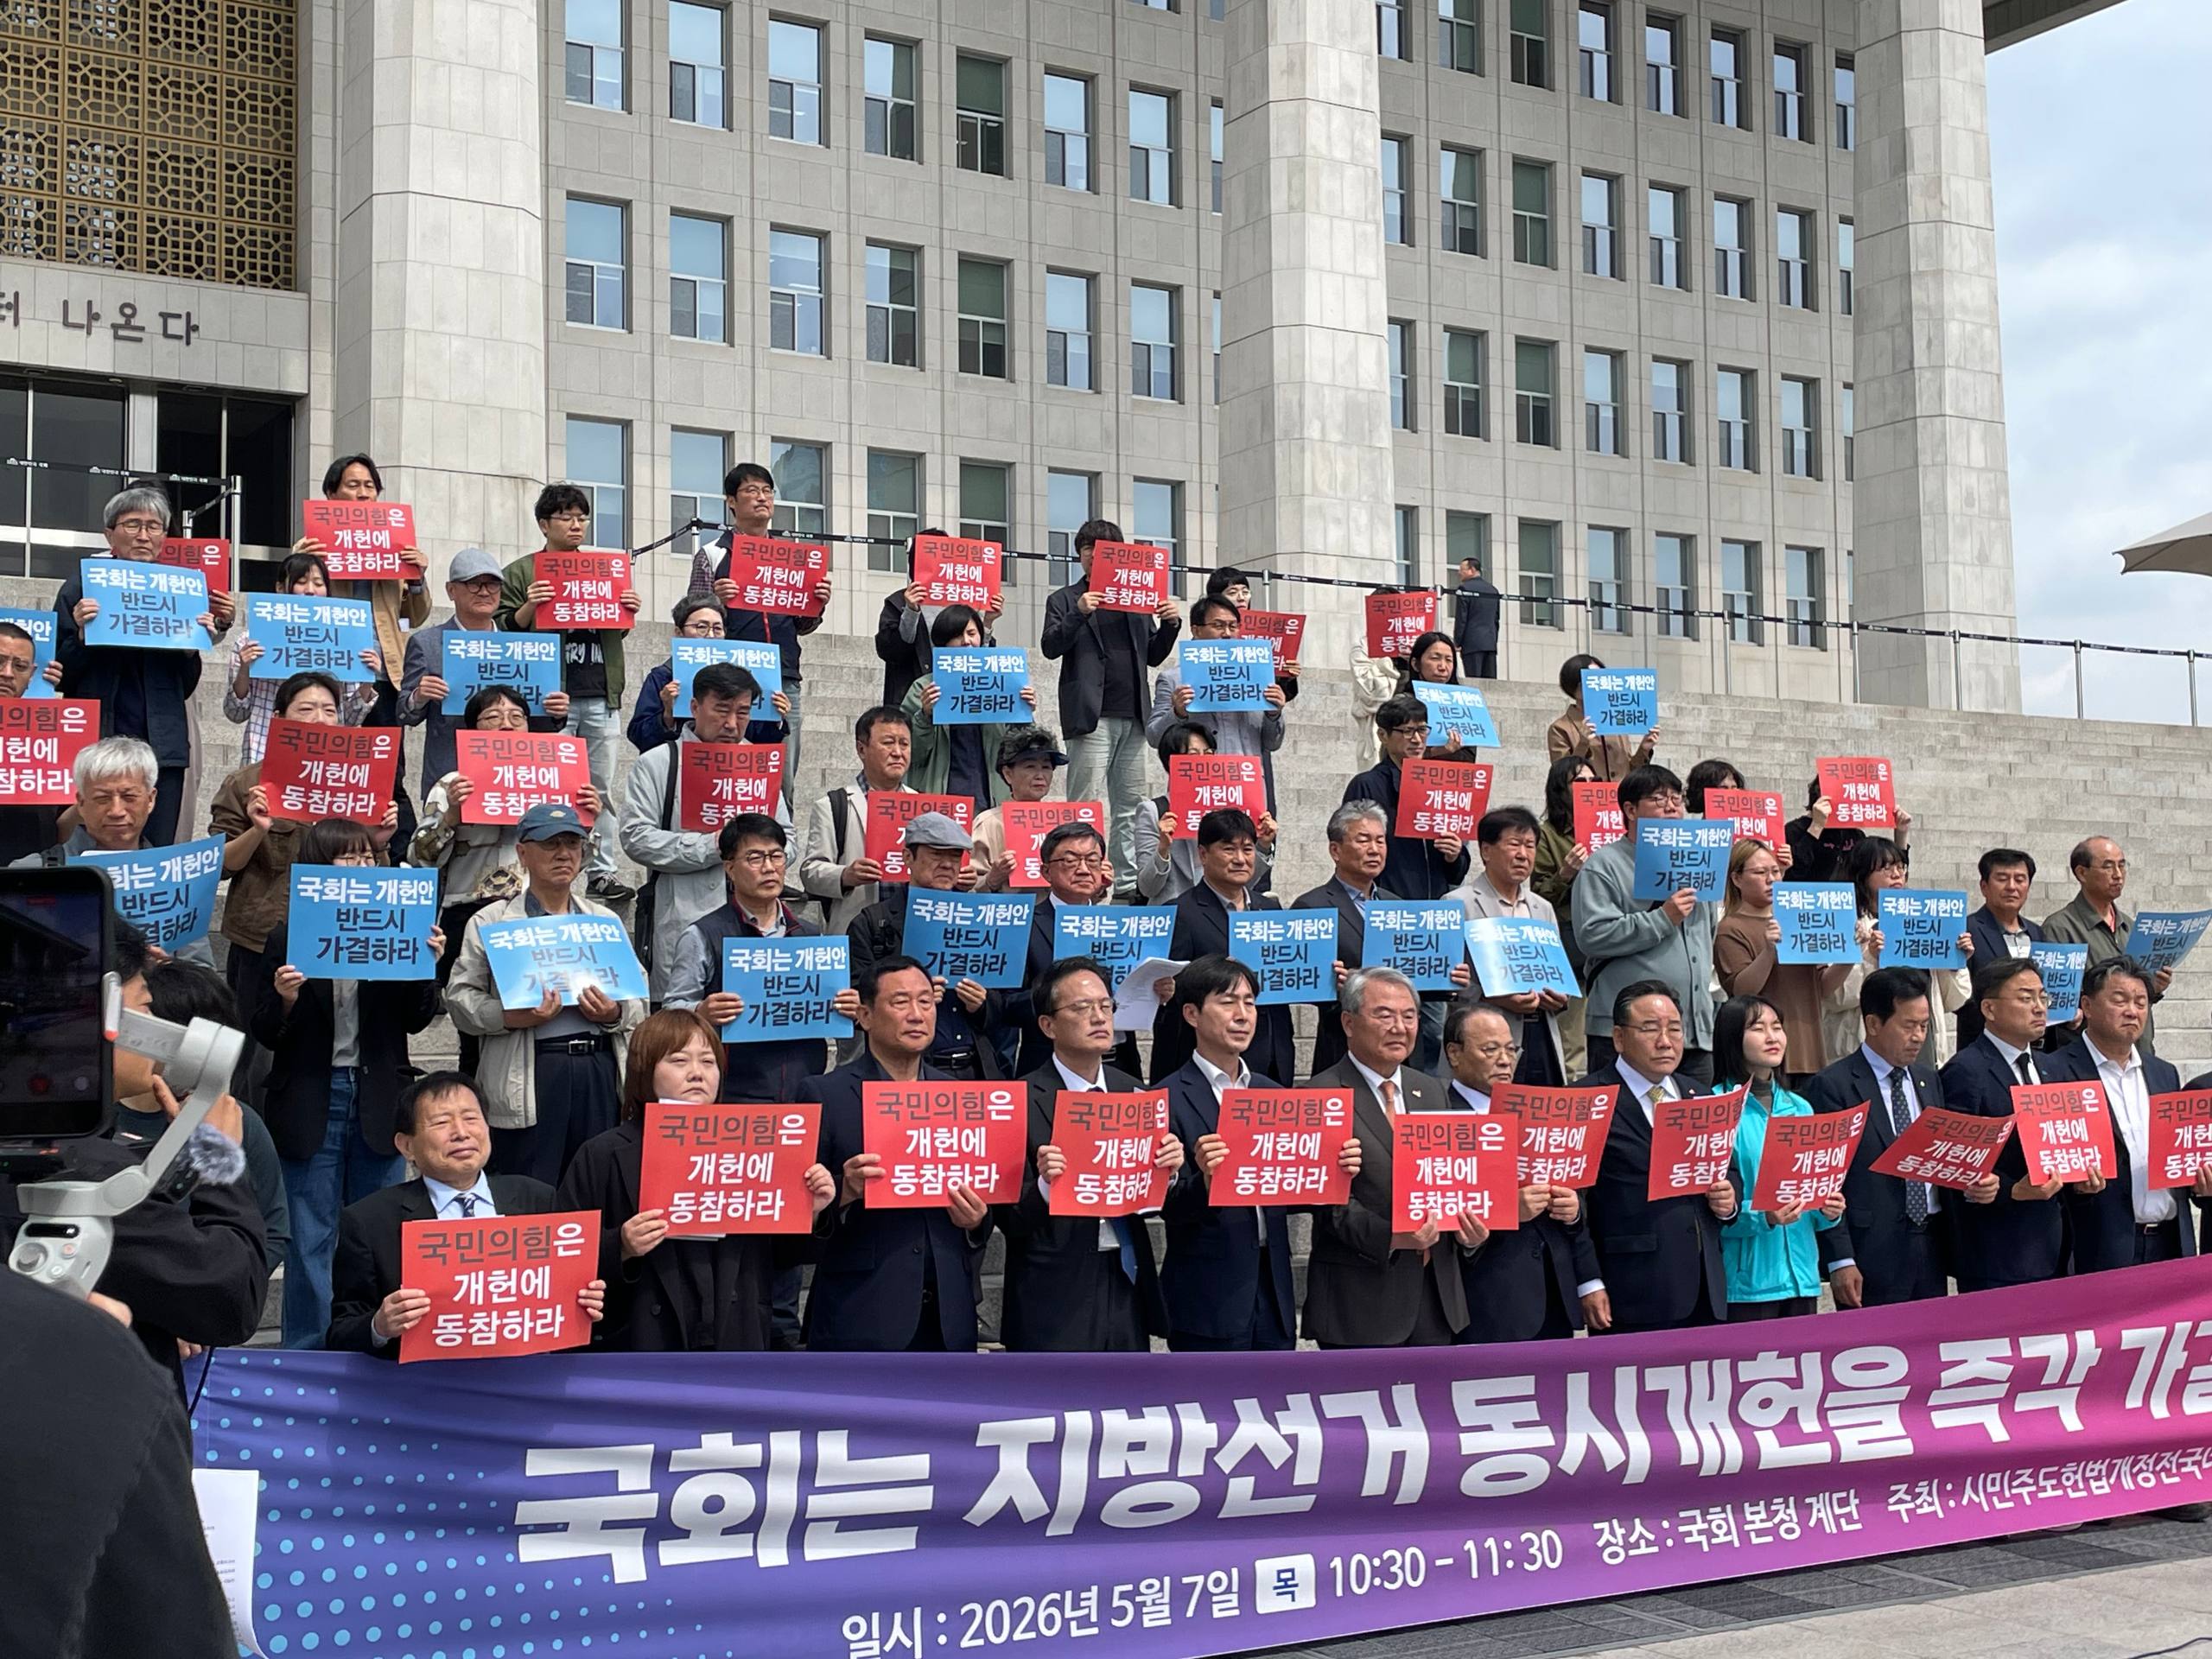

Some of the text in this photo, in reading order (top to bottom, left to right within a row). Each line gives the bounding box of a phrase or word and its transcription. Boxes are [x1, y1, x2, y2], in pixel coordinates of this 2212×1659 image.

[62, 299, 200, 346] 나온다
[313, 505, 406, 529] 국민의힘은
[334, 530, 391, 550] 개헌에
[325, 552, 401, 574] 동참하라
[739, 541, 823, 569] 국민의힘은
[922, 541, 996, 565] 국민의힘은
[1100, 546, 1165, 570] 국민의힘은
[543, 557, 626, 578] 국민의힘은
[754, 565, 805, 589] 개헌에
[938, 563, 982, 584] 개헌에
[1113, 568, 1154, 588] 개헌에
[87, 567, 204, 597] 국회는 개헌안
[562, 581, 613, 600] 개헌에
[929, 582, 989, 605] 동참하라
[121, 592, 177, 614] 반드시
[743, 588, 809, 610] 동참하라
[1103, 586, 1160, 608] 동참하라
[253, 601, 367, 626] 국회는 개헌안
[552, 601, 620, 622] 동참하라
[109, 613, 194, 638] 가결하라
[284, 626, 340, 646] 반드시
[272, 646, 354, 671] 가결하라
[448, 639, 556, 662] 국회는 개헌안
[730, 648, 776, 670] 개헌안
[1183, 645, 1229, 664] 국회는
[1230, 646, 1270, 664] 개헌안
[478, 662, 529, 682] 반드시
[937, 655, 1025, 673] 국회는 개헌안
[1208, 665, 1250, 682] 반드시
[961, 674, 1005, 693] 반드시
[1198, 683, 1262, 702] 가결하라
[1586, 674, 1655, 692] 국회는 개헌안
[950, 693, 1015, 715] 가결하라
[1607, 692, 1641, 709] 반드시
[1438, 706, 1473, 721] 반드시
[1599, 709, 1648, 727] 가결하라
[278, 727, 391, 760] 국민의힘은
[467, 737, 578, 765] 국민의힘은
[692, 748, 780, 774] 국민의힘은
[1178, 761, 1256, 783] 국민의힘은
[298, 760, 370, 789] 개헌에
[493, 766, 560, 790] 개헌에
[1409, 765, 1487, 790] 국민의힘은
[281, 785, 377, 817] 동참하라
[712, 779, 767, 801] 개헌에
[1194, 785, 1243, 806] 개헌에
[1424, 790, 1472, 812] 개헌에
[1843, 783, 1880, 802] 개헌에
[1413, 811, 1474, 836] 동참하라
[1836, 803, 1887, 823] 동참하라
[1642, 827, 1692, 848] 국회는
[1694, 828, 1730, 848] 개헌안
[160, 849, 220, 881] 개헌안
[1669, 849, 1711, 868] 반드시
[296, 876, 435, 906] 국회는 개헌안
[1654, 871, 1717, 892] 가결하라
[122, 885, 190, 918] 반드시
[912, 899, 1030, 926] 국회는 개헌안
[1776, 891, 1853, 911] 국회는 개헌안
[1883, 897, 1964, 918] 국회는 개헌안
[336, 907, 406, 933] 반드시
[1060, 916, 1171, 938] 국회는 개헌안
[1234, 918, 1334, 943] 국회는 개헌안
[1370, 909, 1461, 931] 국회는 개헌안
[1798, 912, 1835, 931] 반드시
[1904, 918, 1942, 937] 반드시
[2137, 918, 2176, 936] 국회는
[489, 923, 622, 950] 국회는 개헌안
[943, 928, 999, 950] 반드시
[1394, 933, 1440, 953] 반드시
[1791, 932, 1847, 953] 가결하라
[1894, 938, 1950, 958] 가결하라
[2153, 936, 2187, 950] 반드시
[316, 937, 419, 965] 가결하라
[532, 946, 598, 968] 반드시
[728, 947, 847, 973] 국회는 개헌안
[1090, 941, 1141, 962] 반드시
[1261, 944, 1308, 964] 반드시
[1503, 945, 1548, 963] 반드시
[925, 951, 1007, 976] 가결하라
[1499, 963, 1563, 985] 가결하라
[763, 975, 820, 997] 반드시
[2047, 972, 2077, 988] 반드시
[747, 1000, 833, 1027] 가결하라
[875, 1090, 1014, 1122] 국민의힘은
[1230, 1097, 1345, 1128] 국민의힘은
[1503, 1092, 1609, 1123] 국민의힘은
[2019, 1087, 2100, 1116] 국민의힘은
[1067, 1098, 1166, 1132] 국민의힘은
[658, 1114, 806, 1146] 국민의힘은
[1400, 1122, 1505, 1152] 국민의힘은
[1522, 1125, 1587, 1154] 개헌에
[1775, 1111, 1863, 1146] 국민의힘은
[1924, 1115, 2012, 1146] 국민의힘은
[2039, 1117, 2089, 1145] 개헌에
[906, 1126, 987, 1158] 개헌에
[1092, 1135, 1154, 1169] 개헌에
[1249, 1132, 1322, 1161] 개헌에
[1924, 1139, 1991, 1168] 개헌에
[688, 1151, 774, 1185] 개헌에
[1415, 1156, 1478, 1186] 개헌에
[1792, 1144, 1848, 1174] 개헌에
[1896, 1155, 1985, 1187] 동참하라
[2039, 1146, 2102, 1175] 동참하라
[891, 1162, 1000, 1196] 동참하라
[1073, 1169, 1152, 1206] 동참하라
[1233, 1166, 1329, 1196] 동참하라
[668, 1189, 785, 1224] 동참하라
[417, 1223, 585, 1267] 국민의힘은
[453, 1265, 550, 1306] 개헌에
[432, 1304, 564, 1346] 동참하라
[515, 1429, 934, 1584] 국회는
[963, 1382, 1430, 1536] 지방선거
[1451, 1344, 1913, 1498] 동시개헌을
[1926, 1328, 2102, 1444] 즉각
[1887, 1478, 1944, 1525] 주최
[1593, 1488, 1860, 1566] 장소 국회 본청 계단
[841, 1606, 924, 1659] 일시
[958, 1585, 1101, 1649] 2026년
[1110, 1577, 1173, 1628] 5월
[1181, 1567, 1241, 1619] 7일
[1272, 1567, 1300, 1603] 목
[1328, 1547, 1427, 1597] 10:30
